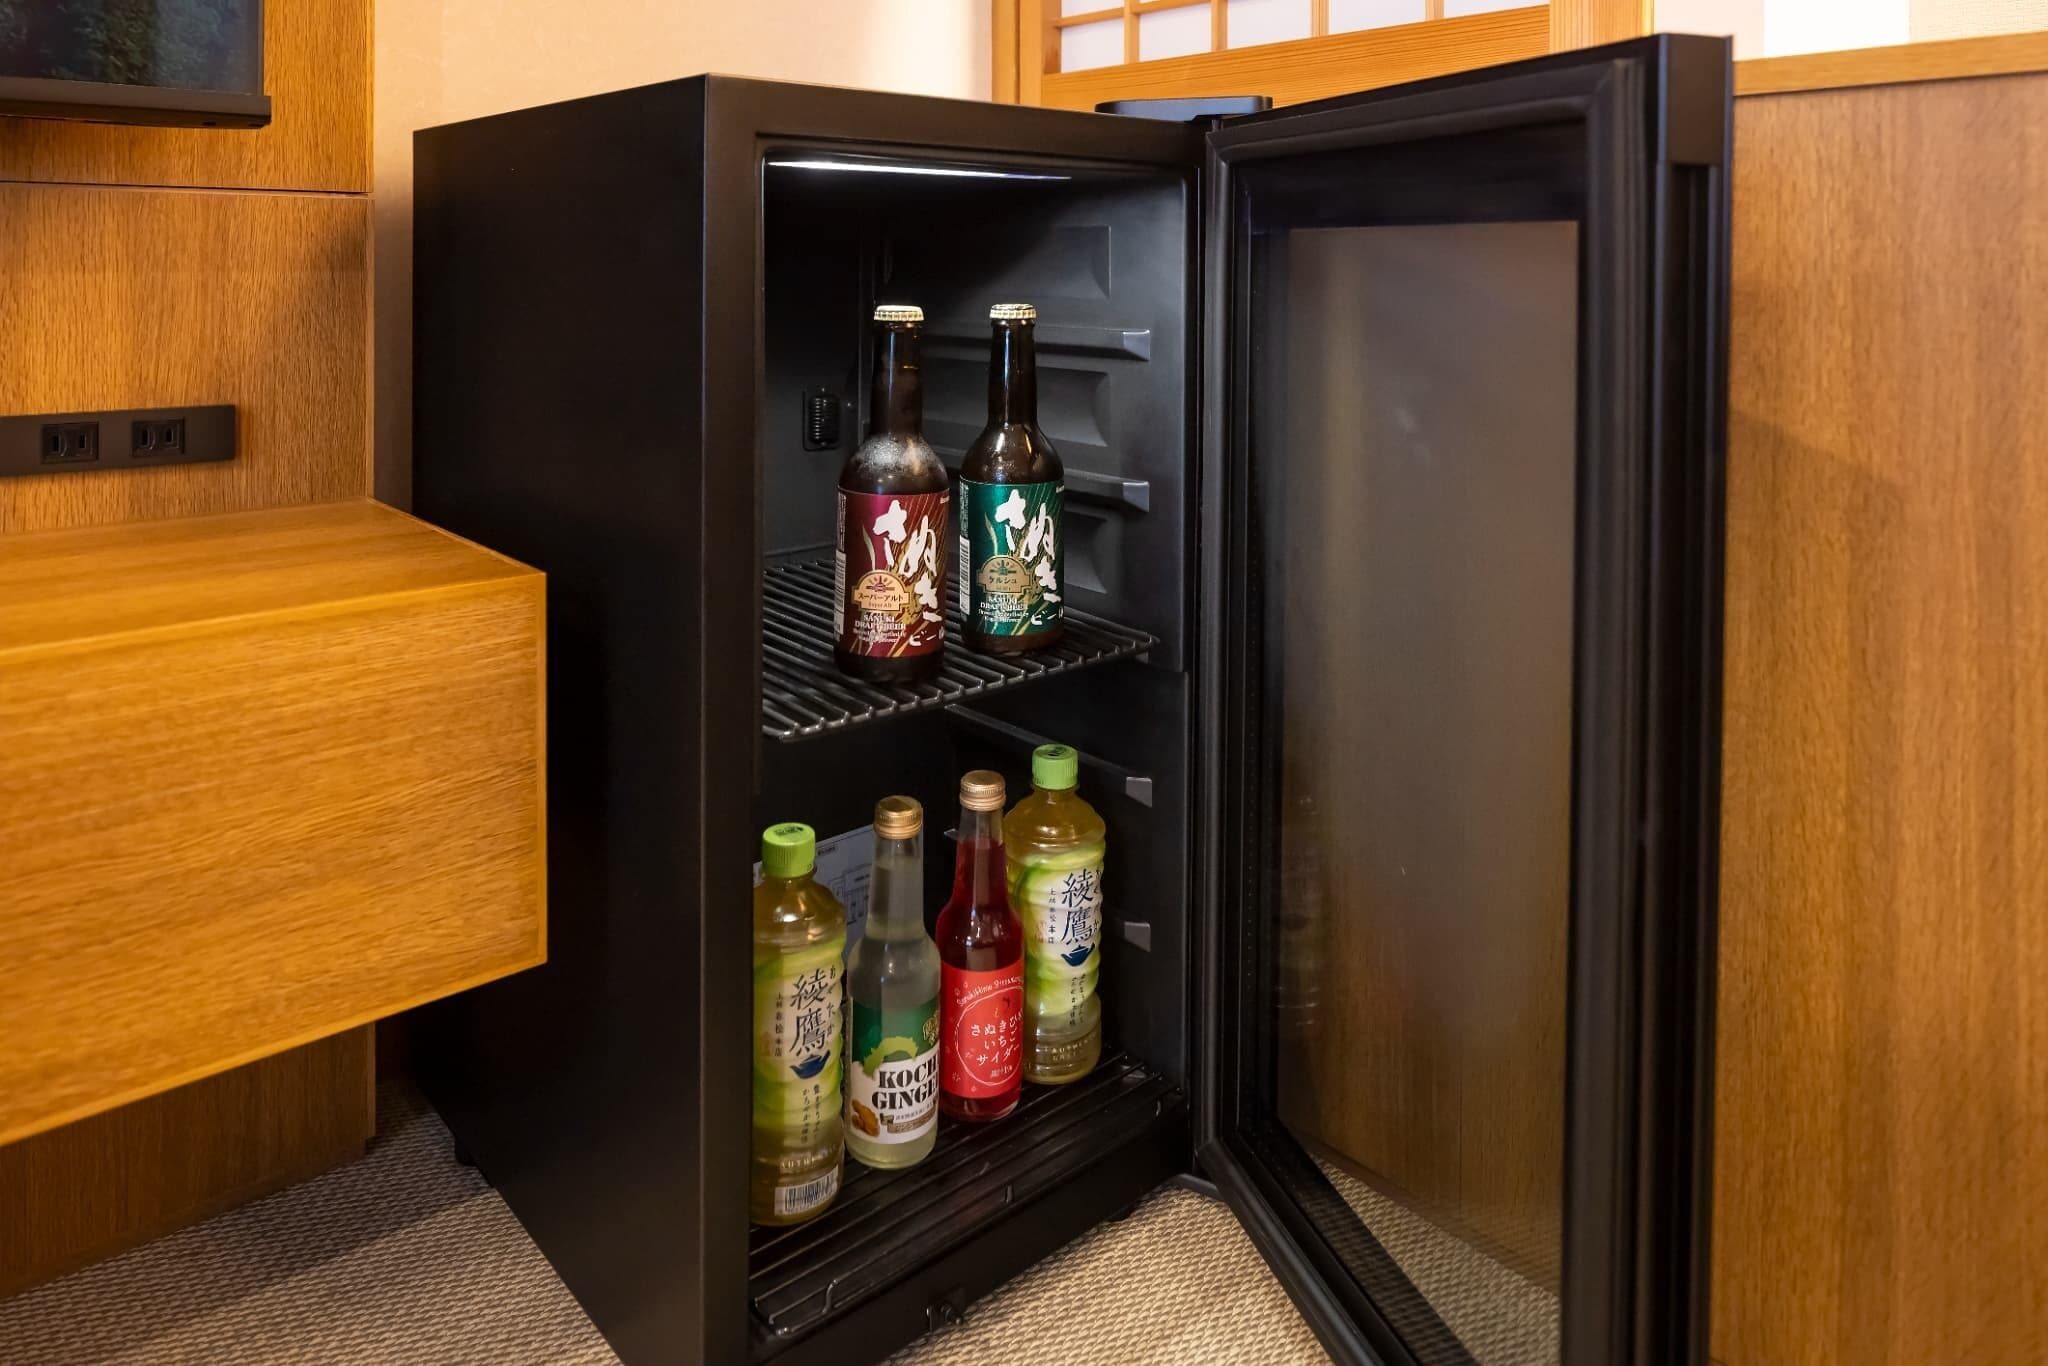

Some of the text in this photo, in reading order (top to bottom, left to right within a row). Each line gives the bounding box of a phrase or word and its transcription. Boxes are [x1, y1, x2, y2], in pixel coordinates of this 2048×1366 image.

[988, 576, 1017, 584] ケルシュ
[858, 593, 904, 602] スーパーアルト
[1061, 868, 1094, 946] 綾鷹
[789, 968, 829, 1056] 綾鷹
[984, 1026, 1018, 1050] いちご
[976, 1043, 1020, 1067] サイダー
[878, 1053, 938, 1089] KOCH
